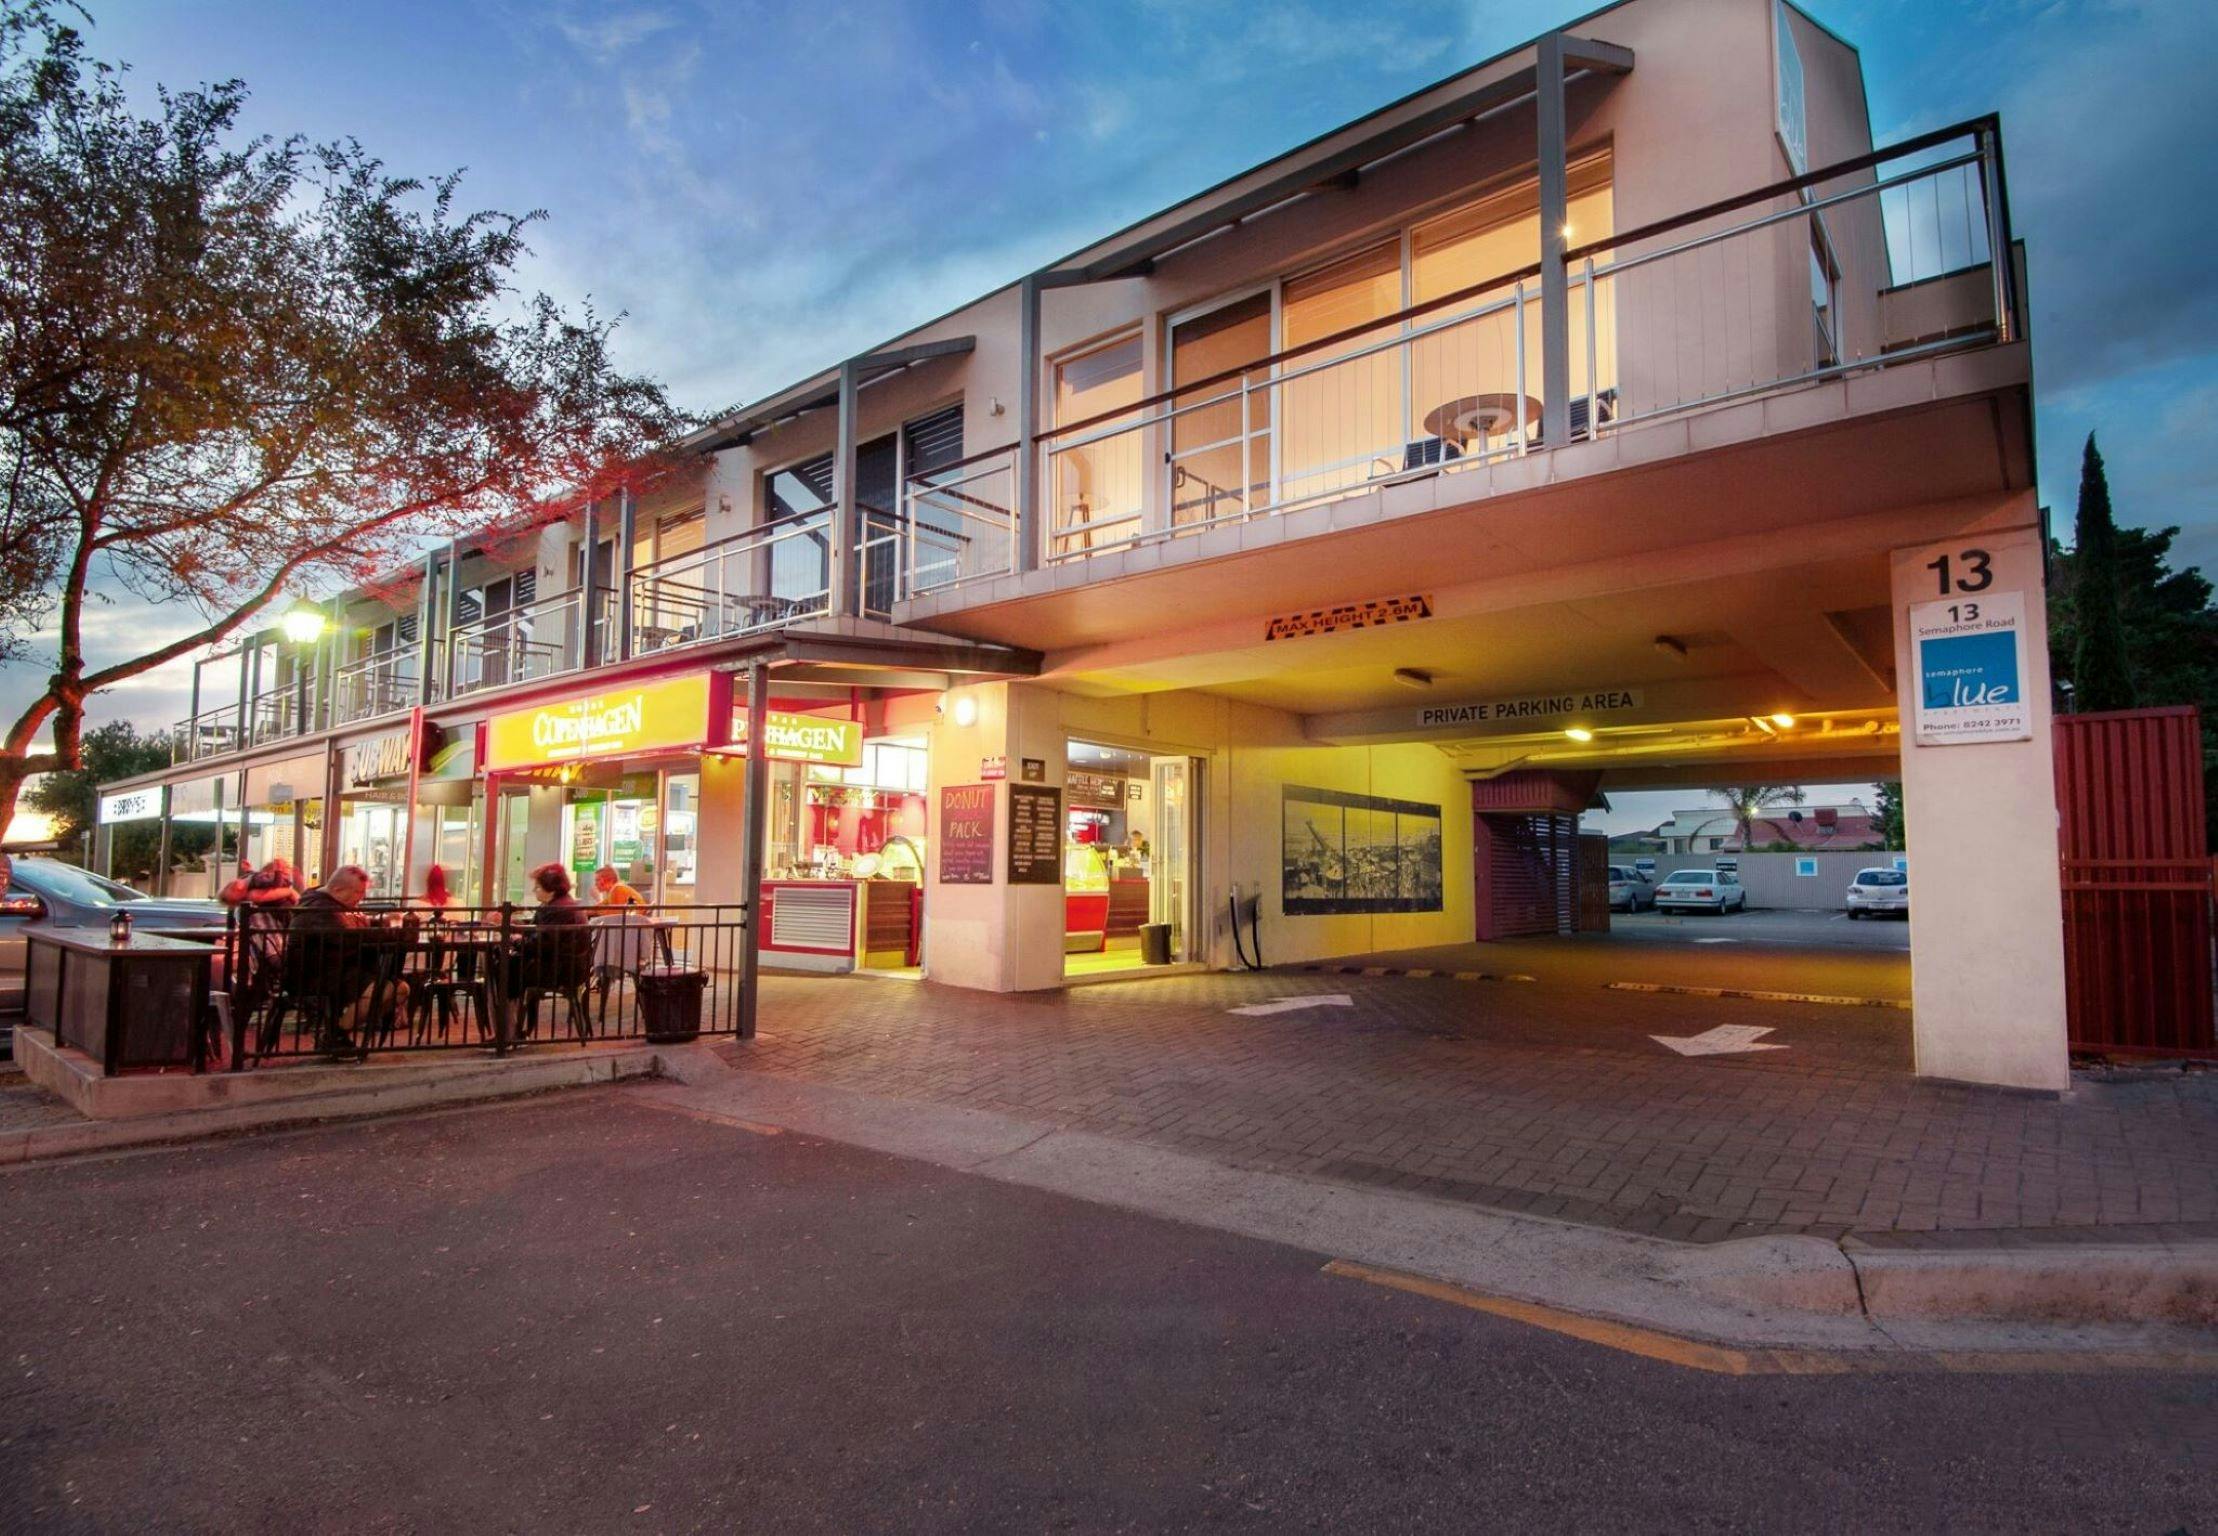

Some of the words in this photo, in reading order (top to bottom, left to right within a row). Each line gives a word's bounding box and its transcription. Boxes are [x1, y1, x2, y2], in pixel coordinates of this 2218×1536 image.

[1927, 549, 1993, 594] 13
[1276, 621, 1308, 633] MAX
[1313, 610, 1374, 628] HEIGHT
[1948, 603, 1979, 622] 13
[1919, 621, 1983, 636] Semaphore
[1985, 616, 2015, 628] Road
[1423, 705, 1488, 724] PRIVATE
[1496, 697, 1573, 718] PARKING
[1581, 691, 1634, 710] AREA
[945, 788, 986, 809] DONUT
[949, 821, 984, 838] PACK
